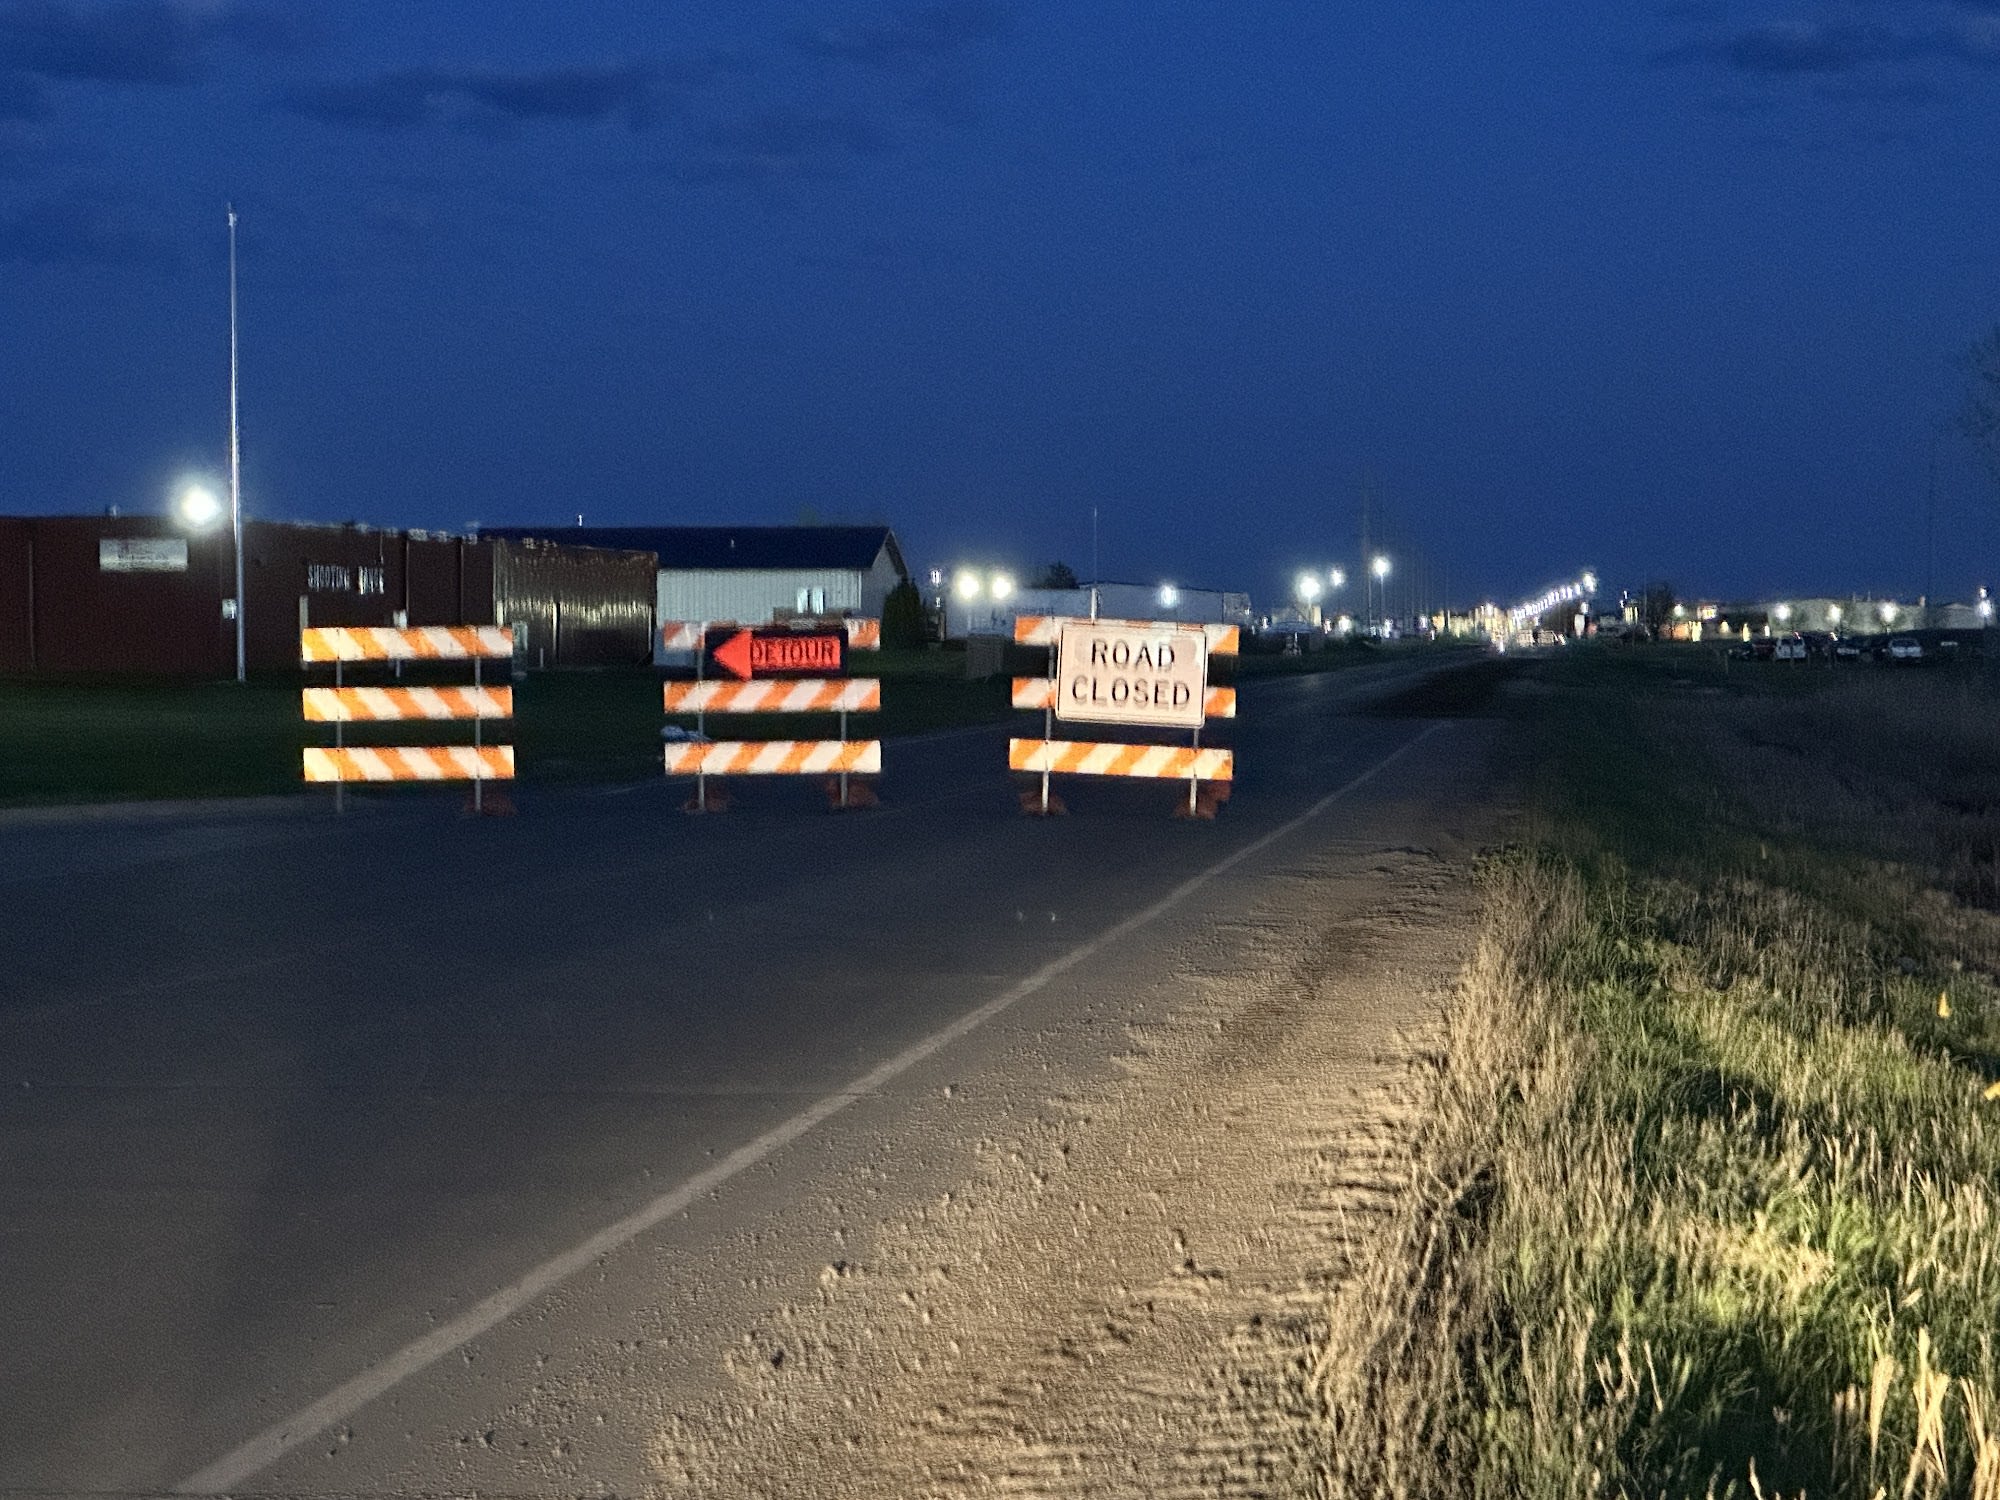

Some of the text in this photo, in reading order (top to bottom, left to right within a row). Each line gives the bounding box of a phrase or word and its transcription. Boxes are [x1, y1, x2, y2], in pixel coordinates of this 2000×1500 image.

[750, 637, 834, 666] DETOUR
[1091, 638, 1176, 671] ROAD
[1071, 674, 1191, 710] CLOSED
